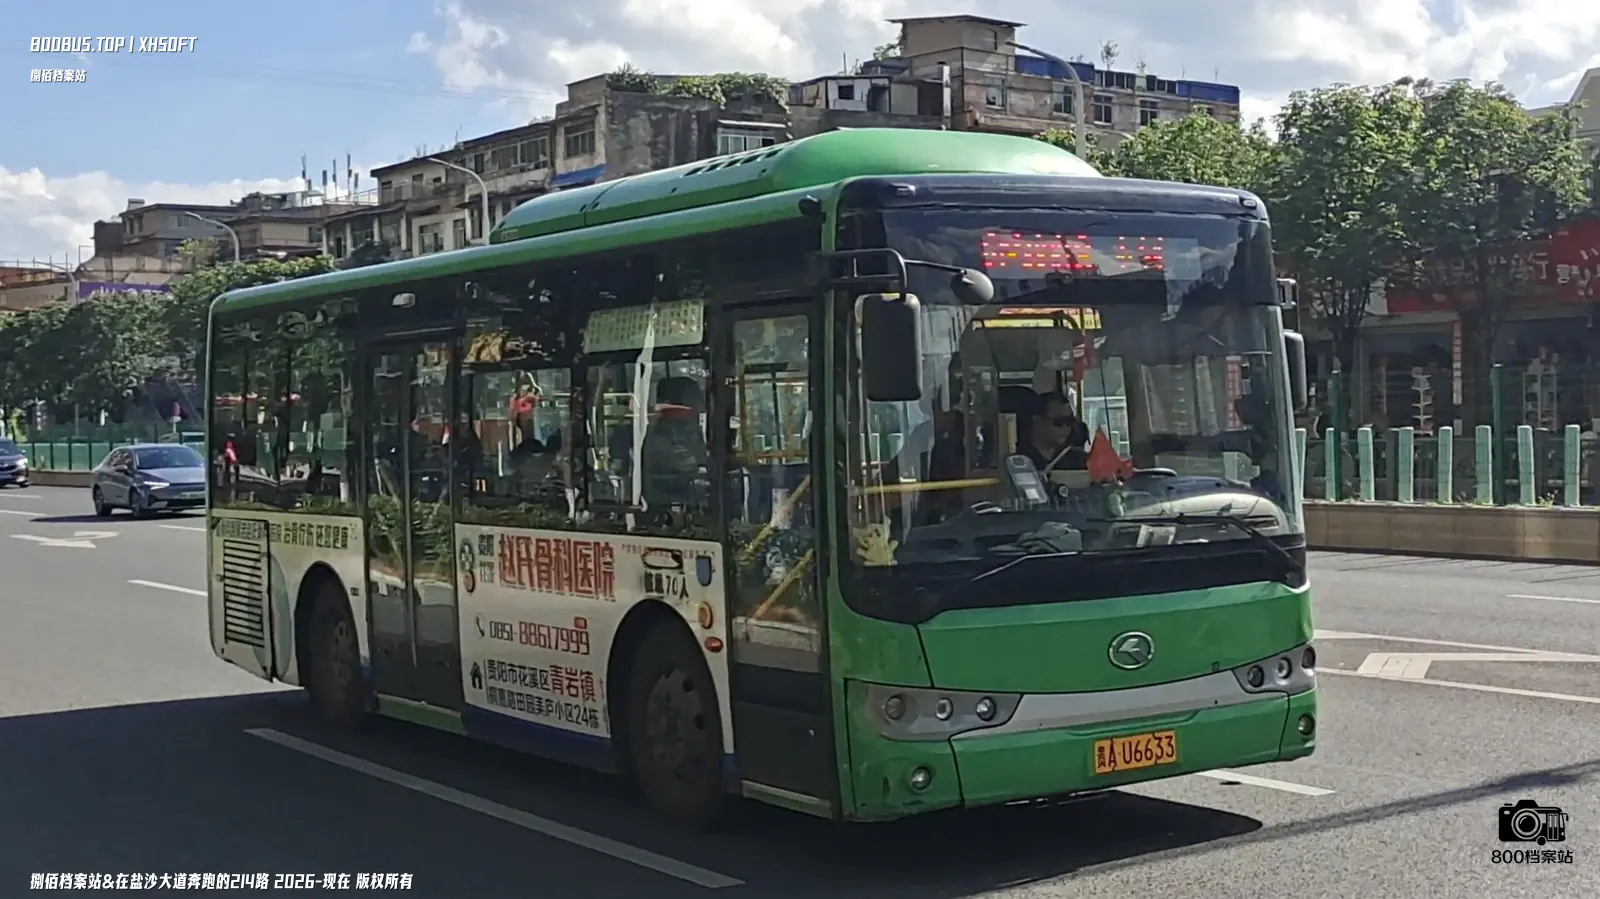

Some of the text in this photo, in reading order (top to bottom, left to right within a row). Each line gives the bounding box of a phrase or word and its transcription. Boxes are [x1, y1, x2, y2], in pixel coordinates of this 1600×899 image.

[498, 533, 616, 597] 赵氏骨科医院
